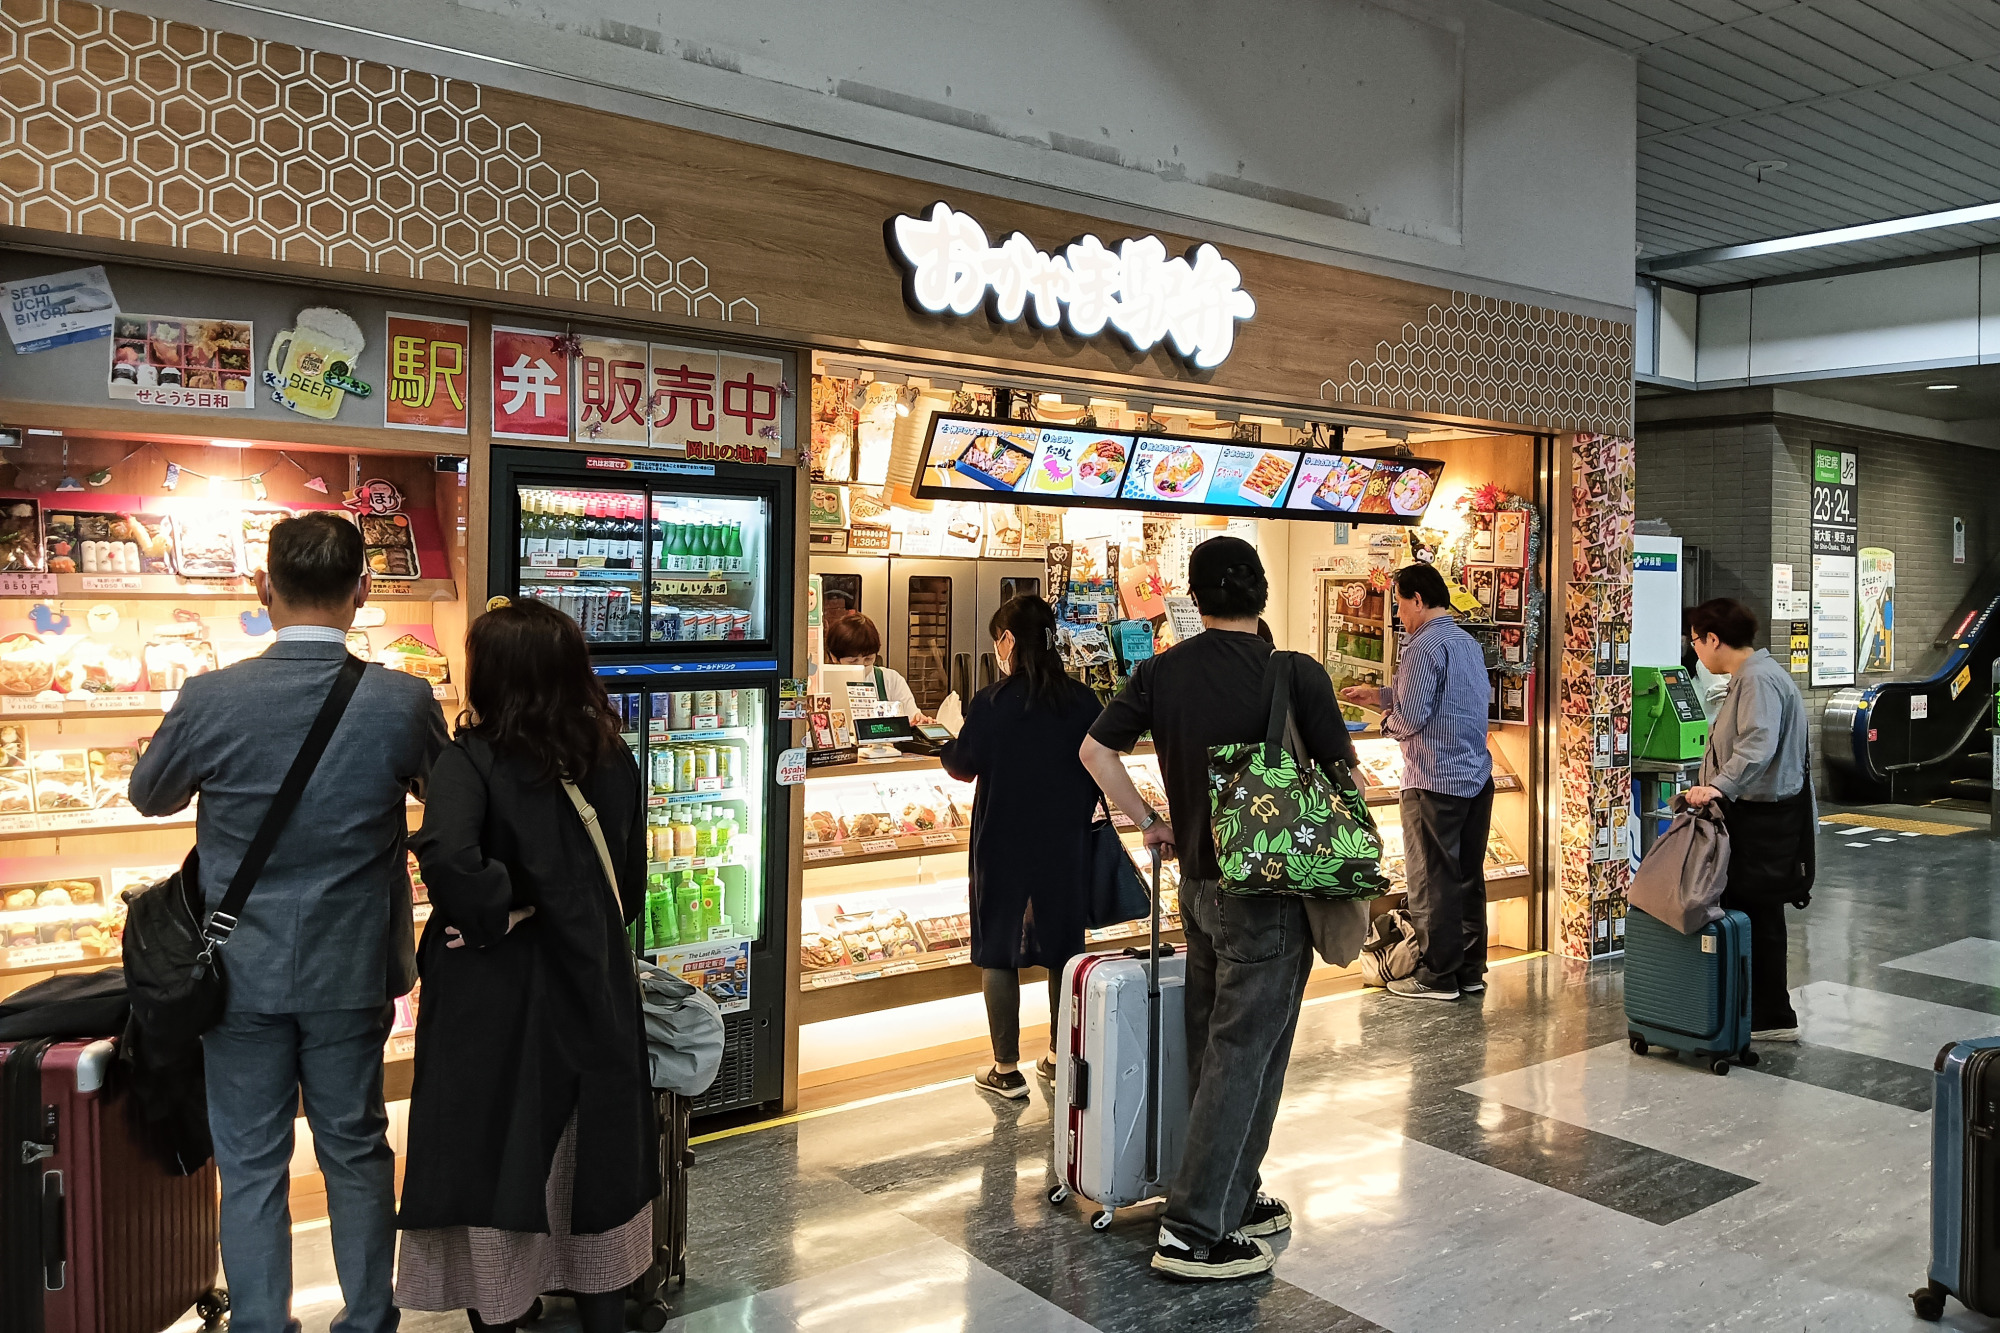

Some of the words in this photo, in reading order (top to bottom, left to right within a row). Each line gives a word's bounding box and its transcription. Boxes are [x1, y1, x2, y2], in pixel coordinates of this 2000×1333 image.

[11, 284, 50, 300] SETO
[895, 201, 1256, 368] おかやま駅弁
[13, 296, 50, 312] UCHI
[15, 305, 67, 326] BIYORI
[290, 373, 332, 400] BEER
[136, 389, 229, 409] せとうち日和
[686, 440, 767, 464] 岡山の地酒
[1046, 446, 1072, 461] たこめし
[1817, 454, 1839, 469] 指定席
[853, 538, 880, 547] 1,380円
[1643, 556, 1662, 566] 伊藤園
[651, 581, 726, 594] おいしいお酒
[596, 604, 606, 632] DRY
[781, 766, 805, 775] Asahi
[684, 959, 725, 971] 数量限定販売
[710, 973, 732, 981] コーヒー
